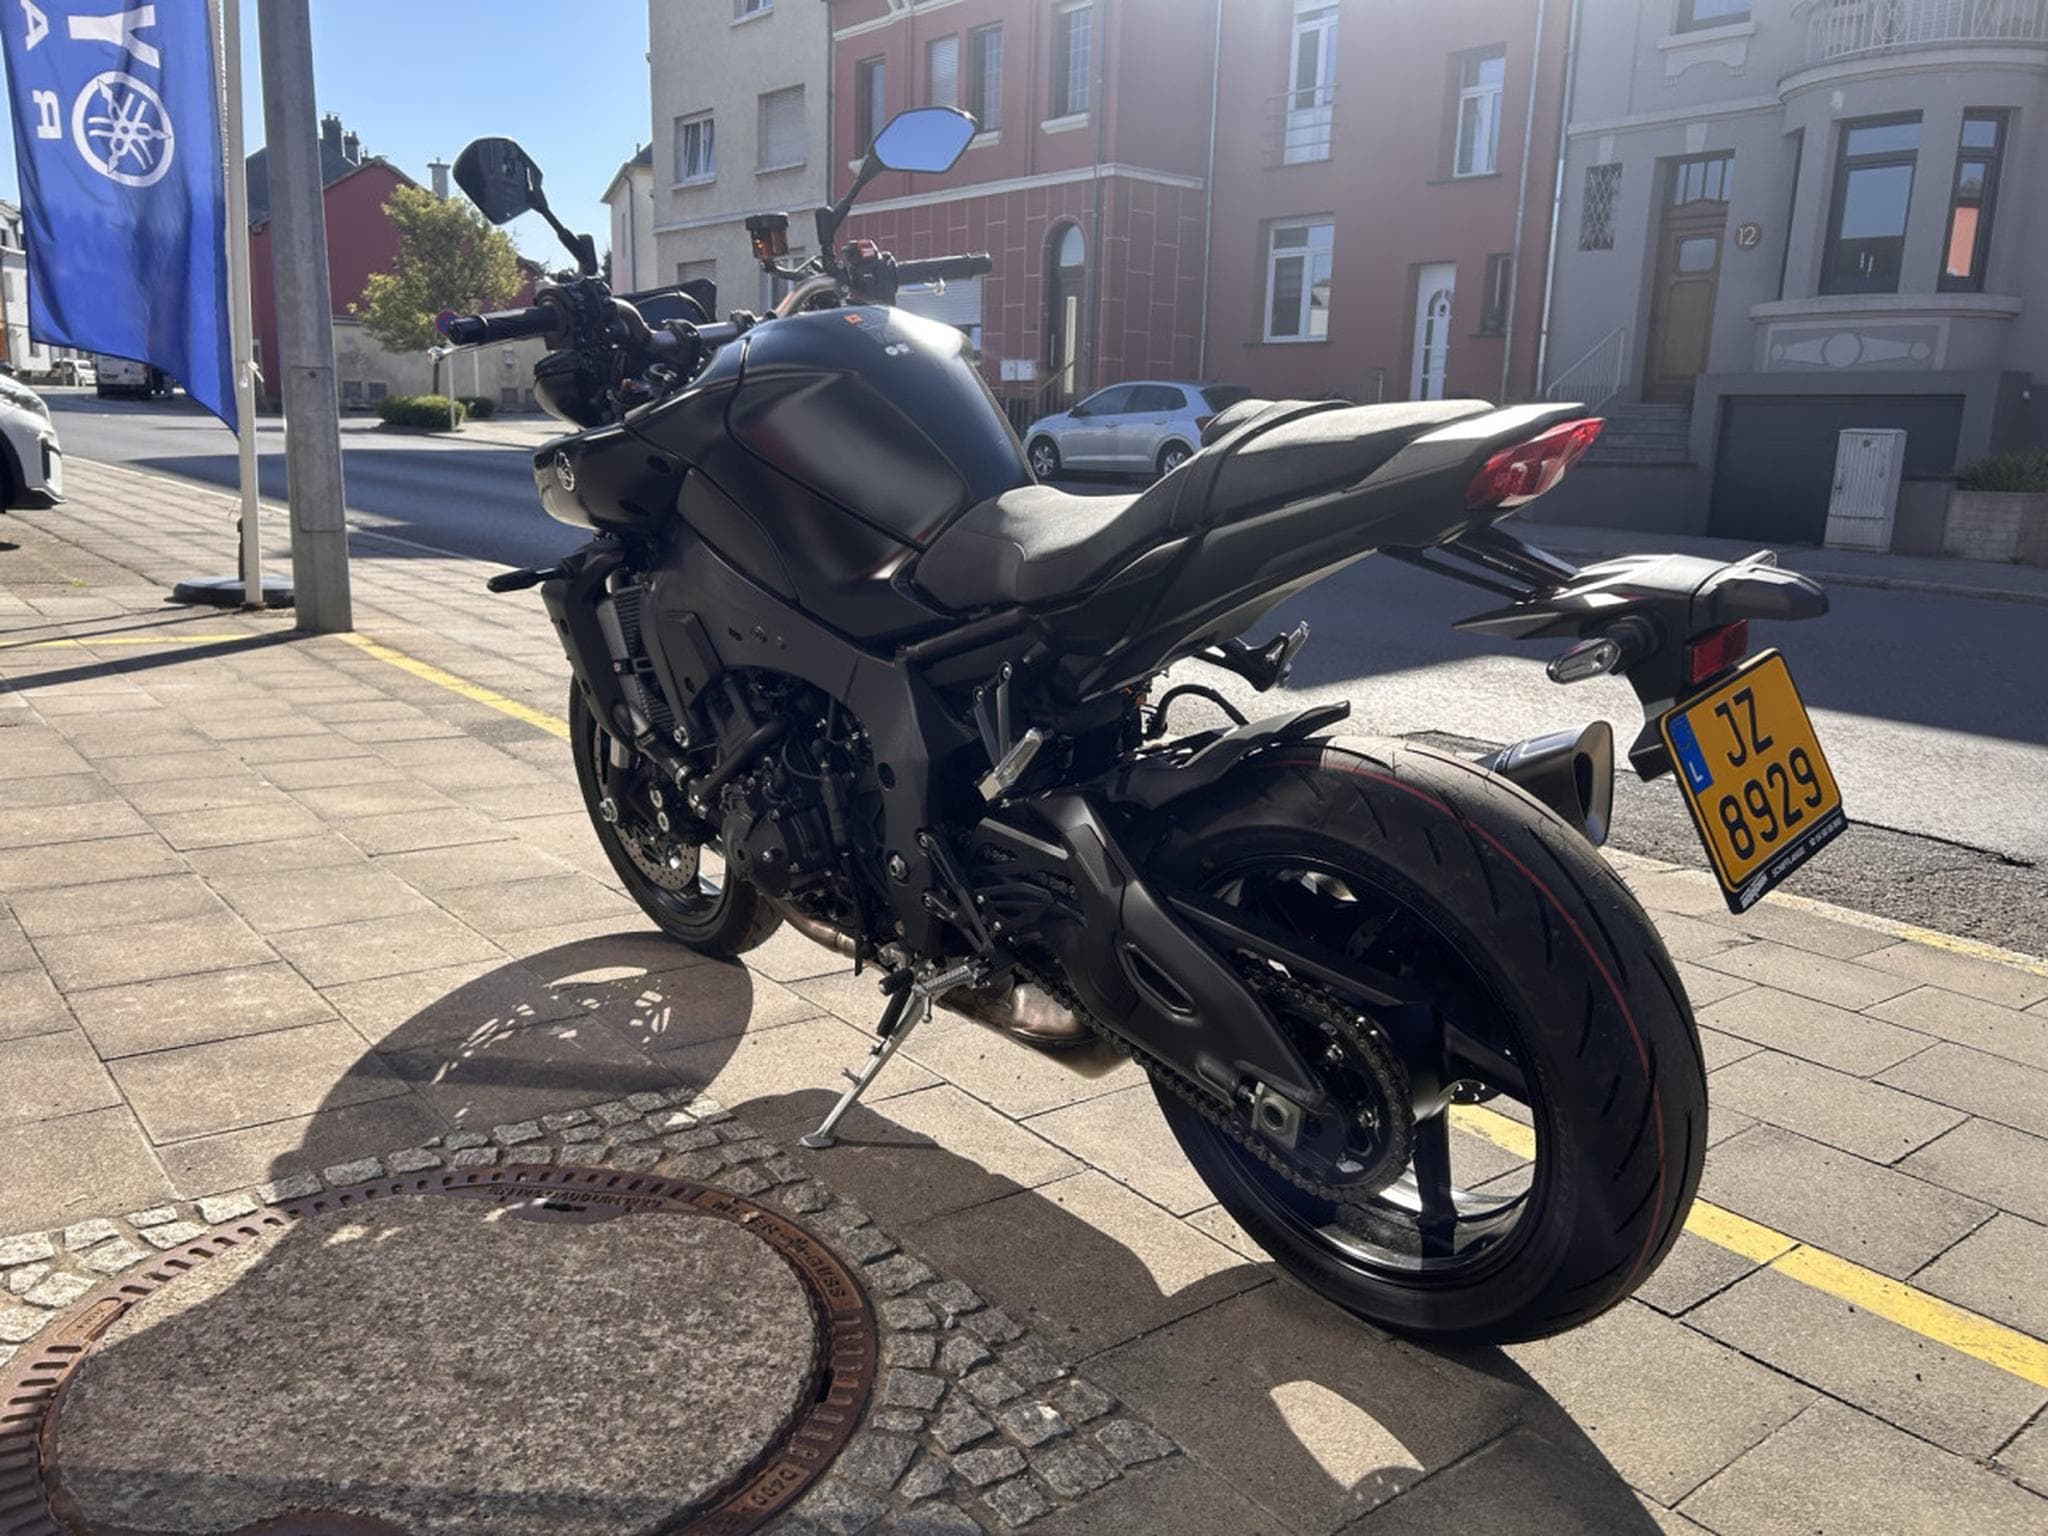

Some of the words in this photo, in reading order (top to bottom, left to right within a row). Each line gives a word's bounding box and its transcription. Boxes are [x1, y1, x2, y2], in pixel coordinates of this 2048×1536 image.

[1738, 225, 1757, 246] 12
[1713, 686, 1774, 768] JZ
[1688, 761, 1704, 784] L
[1718, 746, 1823, 861] 8929
